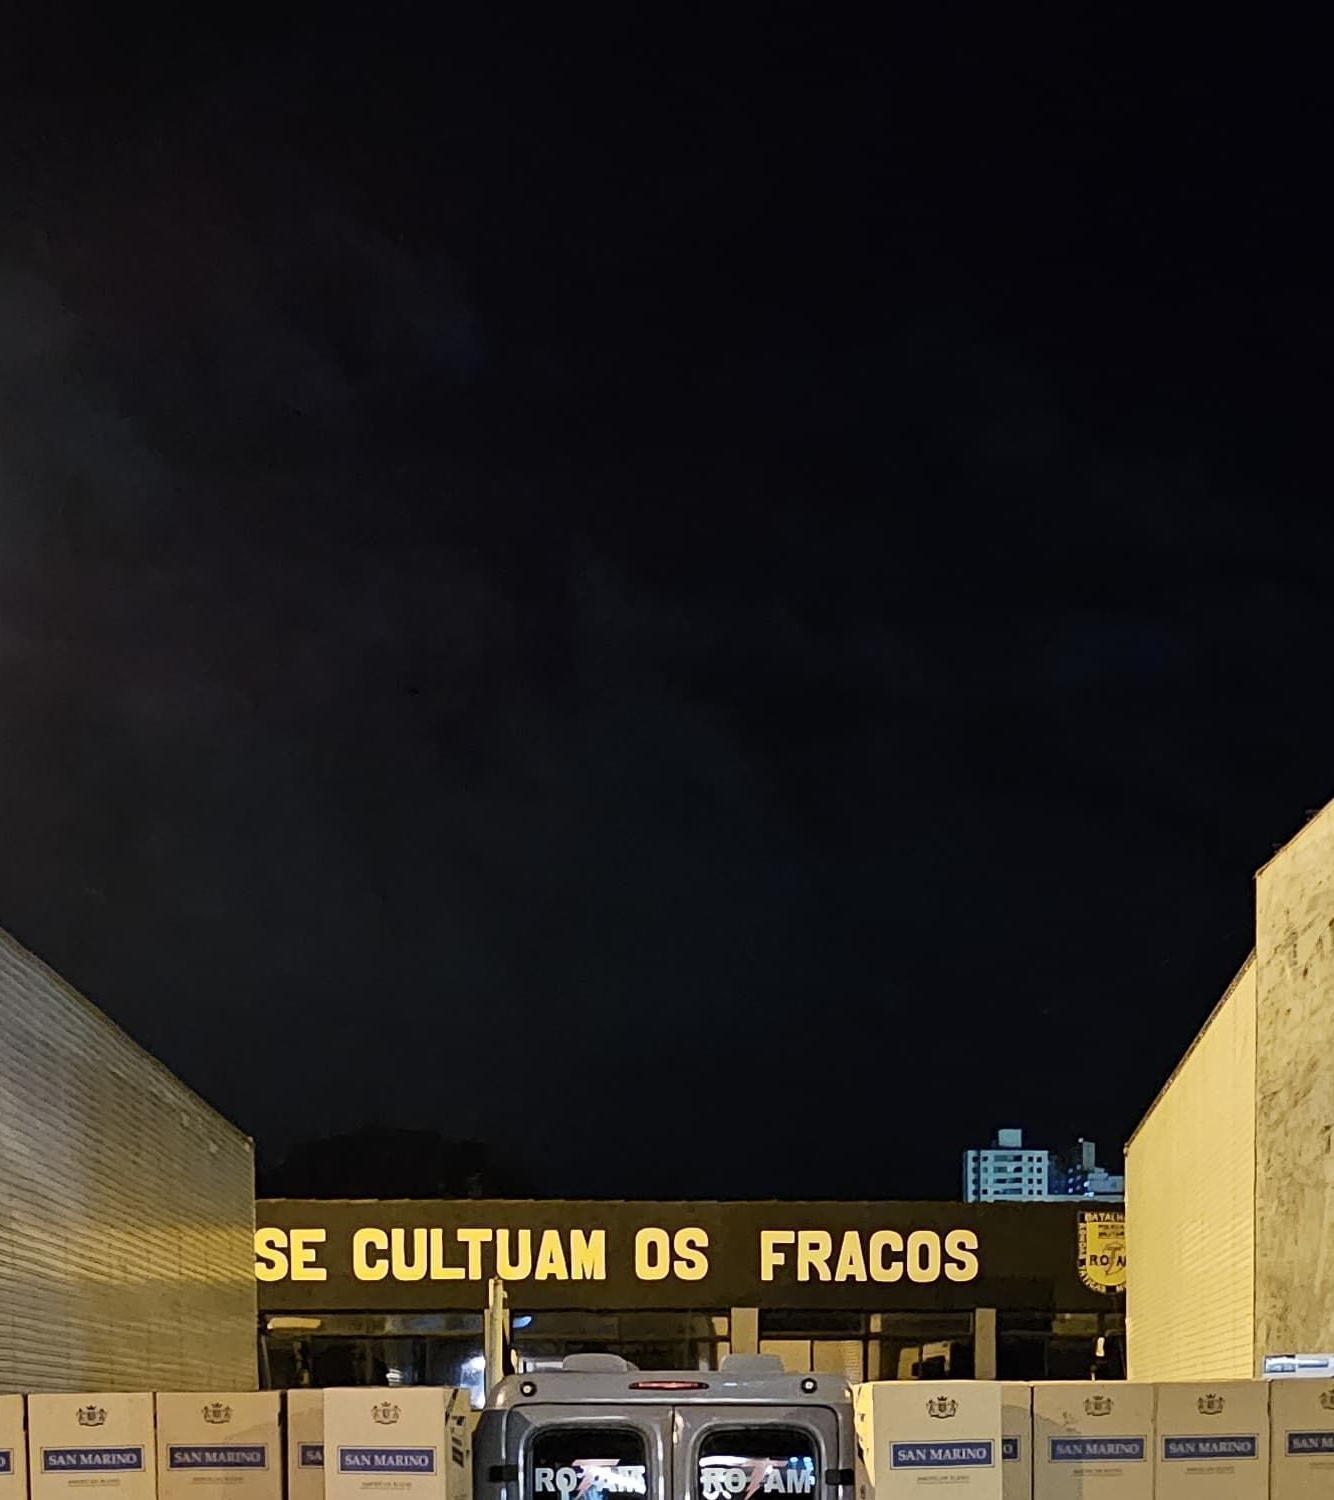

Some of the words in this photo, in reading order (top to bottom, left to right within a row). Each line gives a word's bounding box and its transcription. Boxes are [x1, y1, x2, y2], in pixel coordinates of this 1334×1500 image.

[254, 1228, 327, 1281] SE
[353, 1228, 606, 1281] CULTUAM
[635, 1227, 709, 1280] OS
[761, 1229, 979, 1282] FRACOS
[307, 1450, 323, 1461] SA
[898, 1448, 926, 1461] SAN
[930, 1448, 986, 1461] MARINO
[1056, 1443, 1082, 1455] SAN
[1086, 1443, 1139, 1456] MARINO
[48, 1453, 76, 1466] SAN
[80, 1452, 136, 1465] MARINO
[175, 1451, 202, 1464] SAN
[206, 1451, 261, 1464] MARINO
[345, 1454, 371, 1466] SAN
[375, 1454, 429, 1467] MARINO
[701, 1459, 812, 1500] ROTAM
